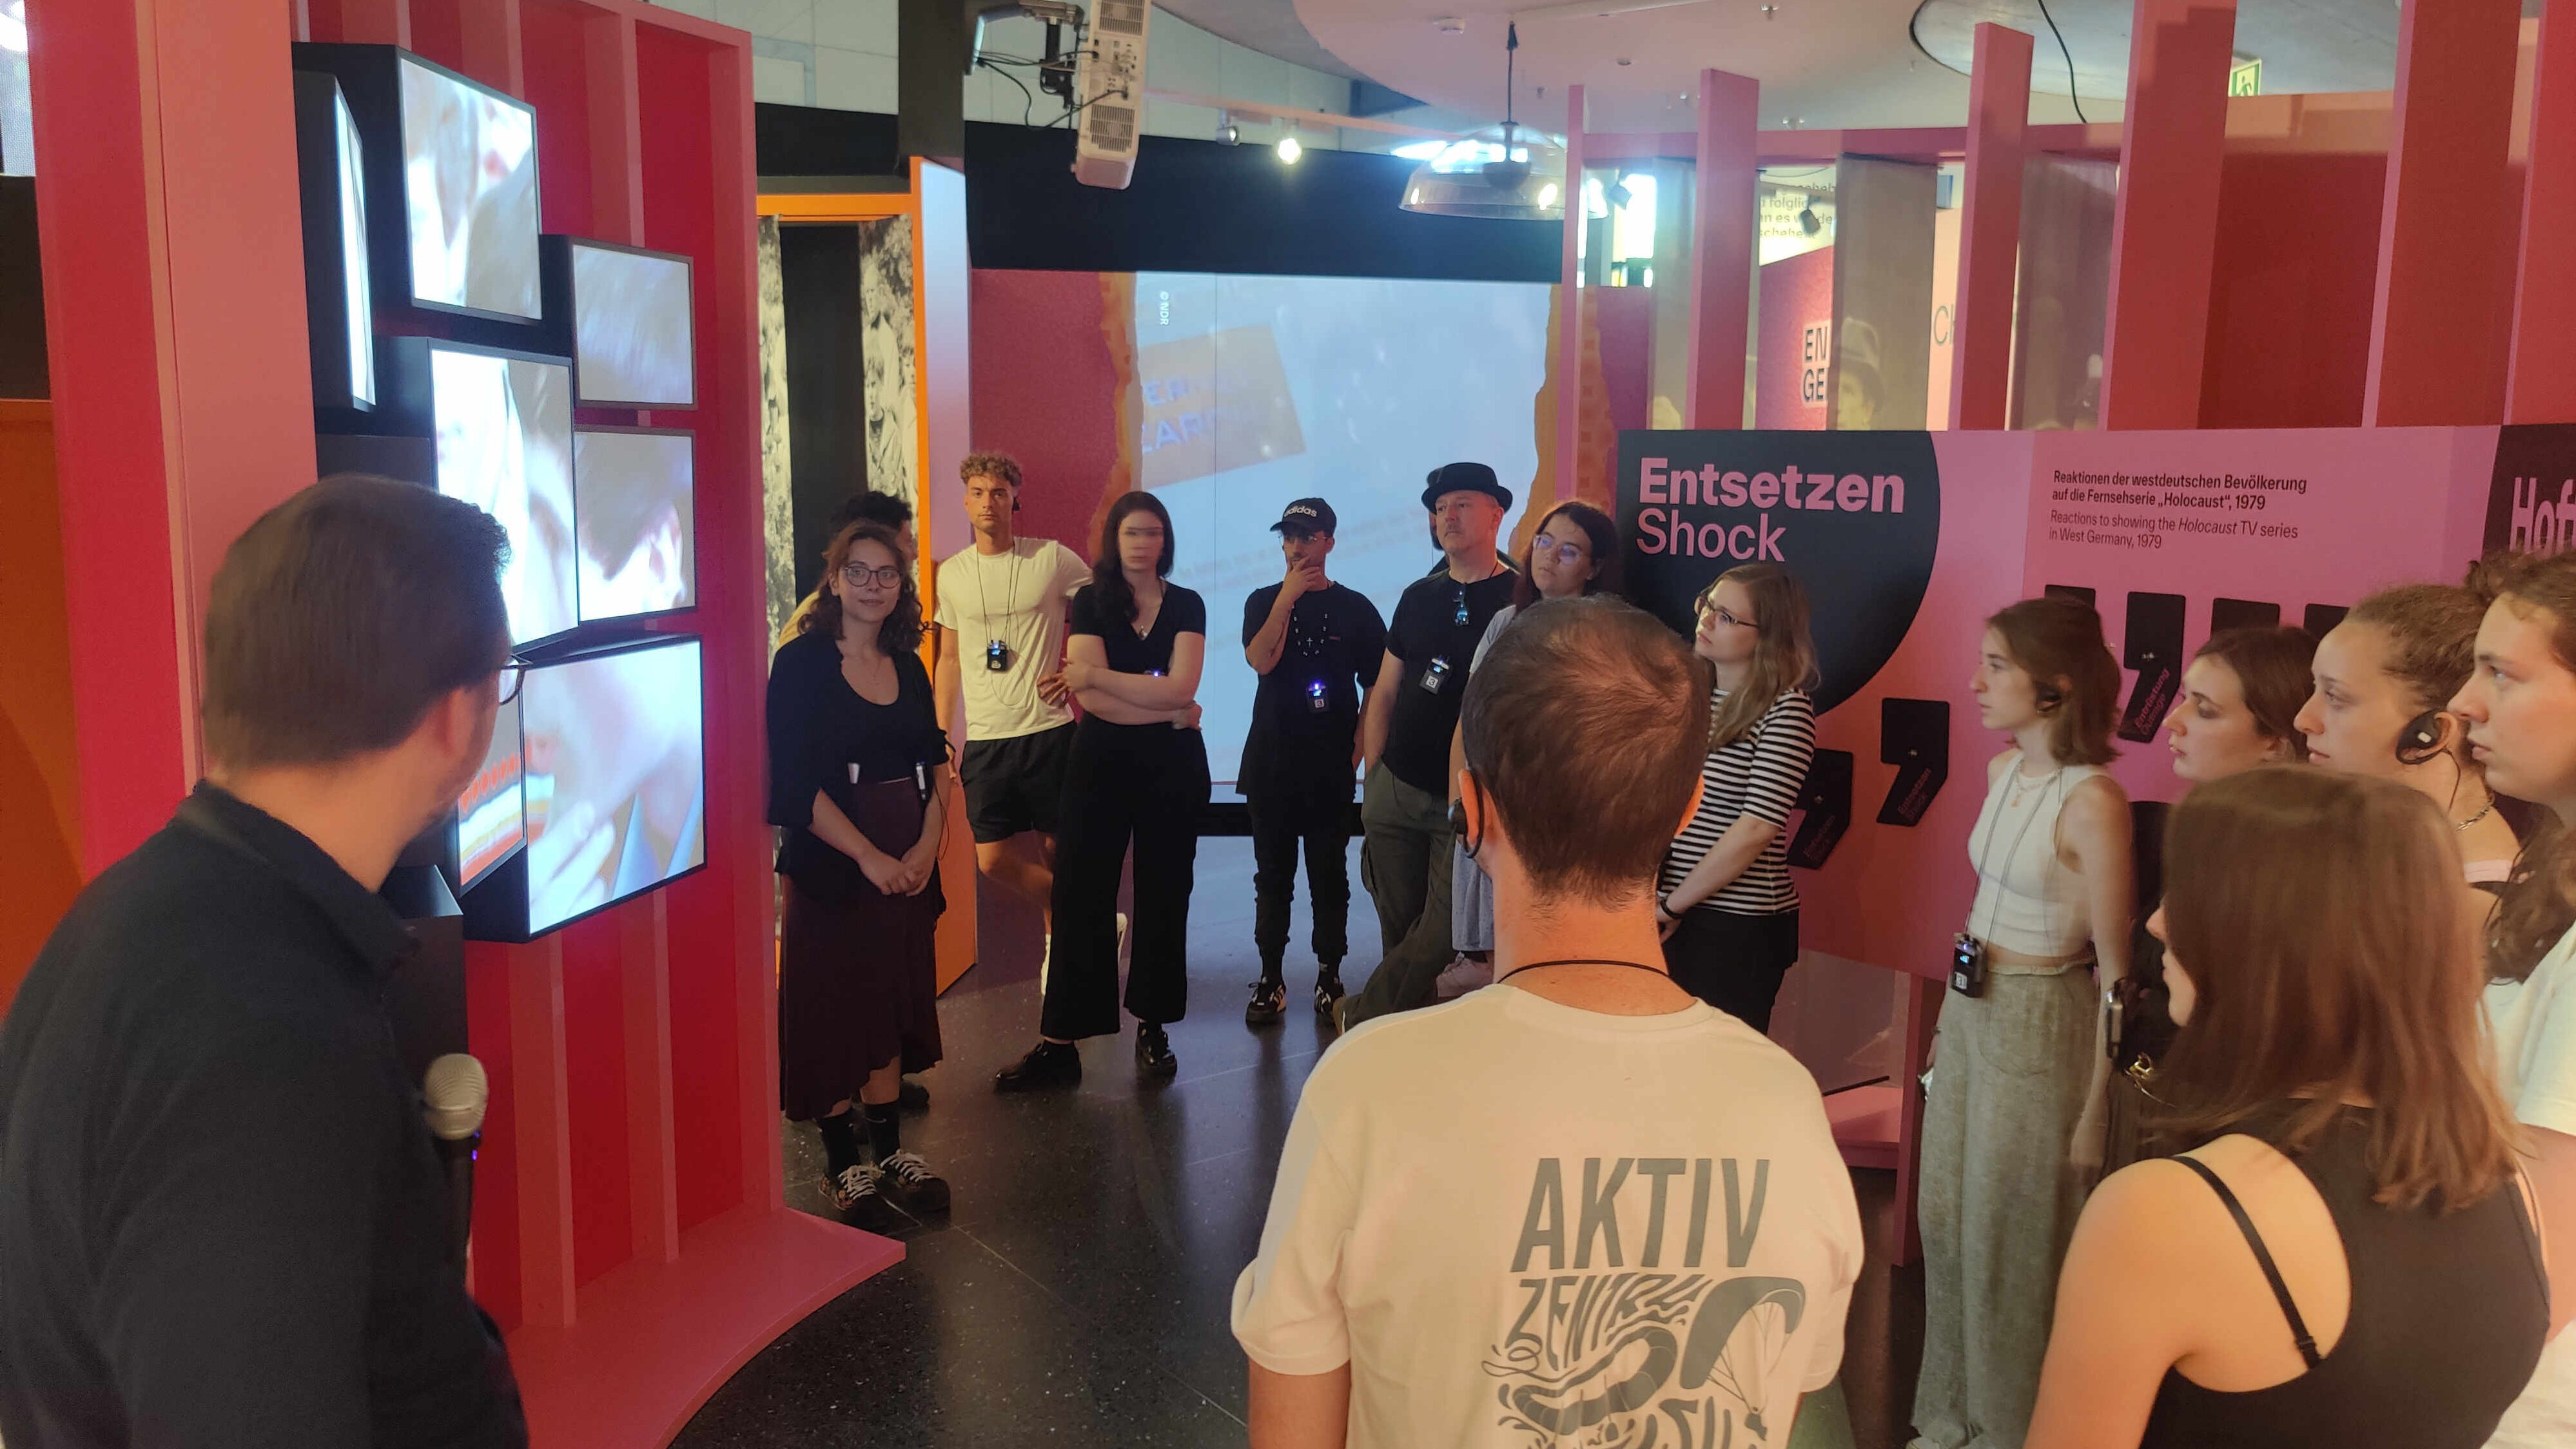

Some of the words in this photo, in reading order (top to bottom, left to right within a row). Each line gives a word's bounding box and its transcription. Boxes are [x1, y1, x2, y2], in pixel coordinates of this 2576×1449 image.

[1160, 302, 1169, 325] NDR
[1639, 458, 1904, 513] Entsetzen
[2054, 471, 2110, 483] Reaktionen
[2113, 472, 2130, 485] der
[2132, 472, 2221, 488] westdeutschen
[2224, 474, 2307, 494] Bevölkerung
[2053, 489, 2068, 500] auf
[2070, 489, 2085, 501] die
[2087, 489, 2156, 505] Fernsehserie
[2236, 495, 2266, 510] 1979
[2051, 510, 2097, 525] Reactions
[2100, 515, 2109, 527] to
[2112, 515, 2156, 532] showing
[2158, 516, 2176, 531] the
[2178, 518, 2237, 534] Holocaust
[2240, 521, 2258, 536] TV
[2260, 523, 2298, 538] series
[2509, 477, 2576, 561] Hof
[1637, 509, 1787, 562] Shock
[2049, 527, 2057, 540] in
[2060, 528, 2084, 542] West
[2087, 530, 2134, 549] Germany,
[2138, 534, 2161, 548] 1979
[1510, 1157, 1770, 1272] AKTIV
